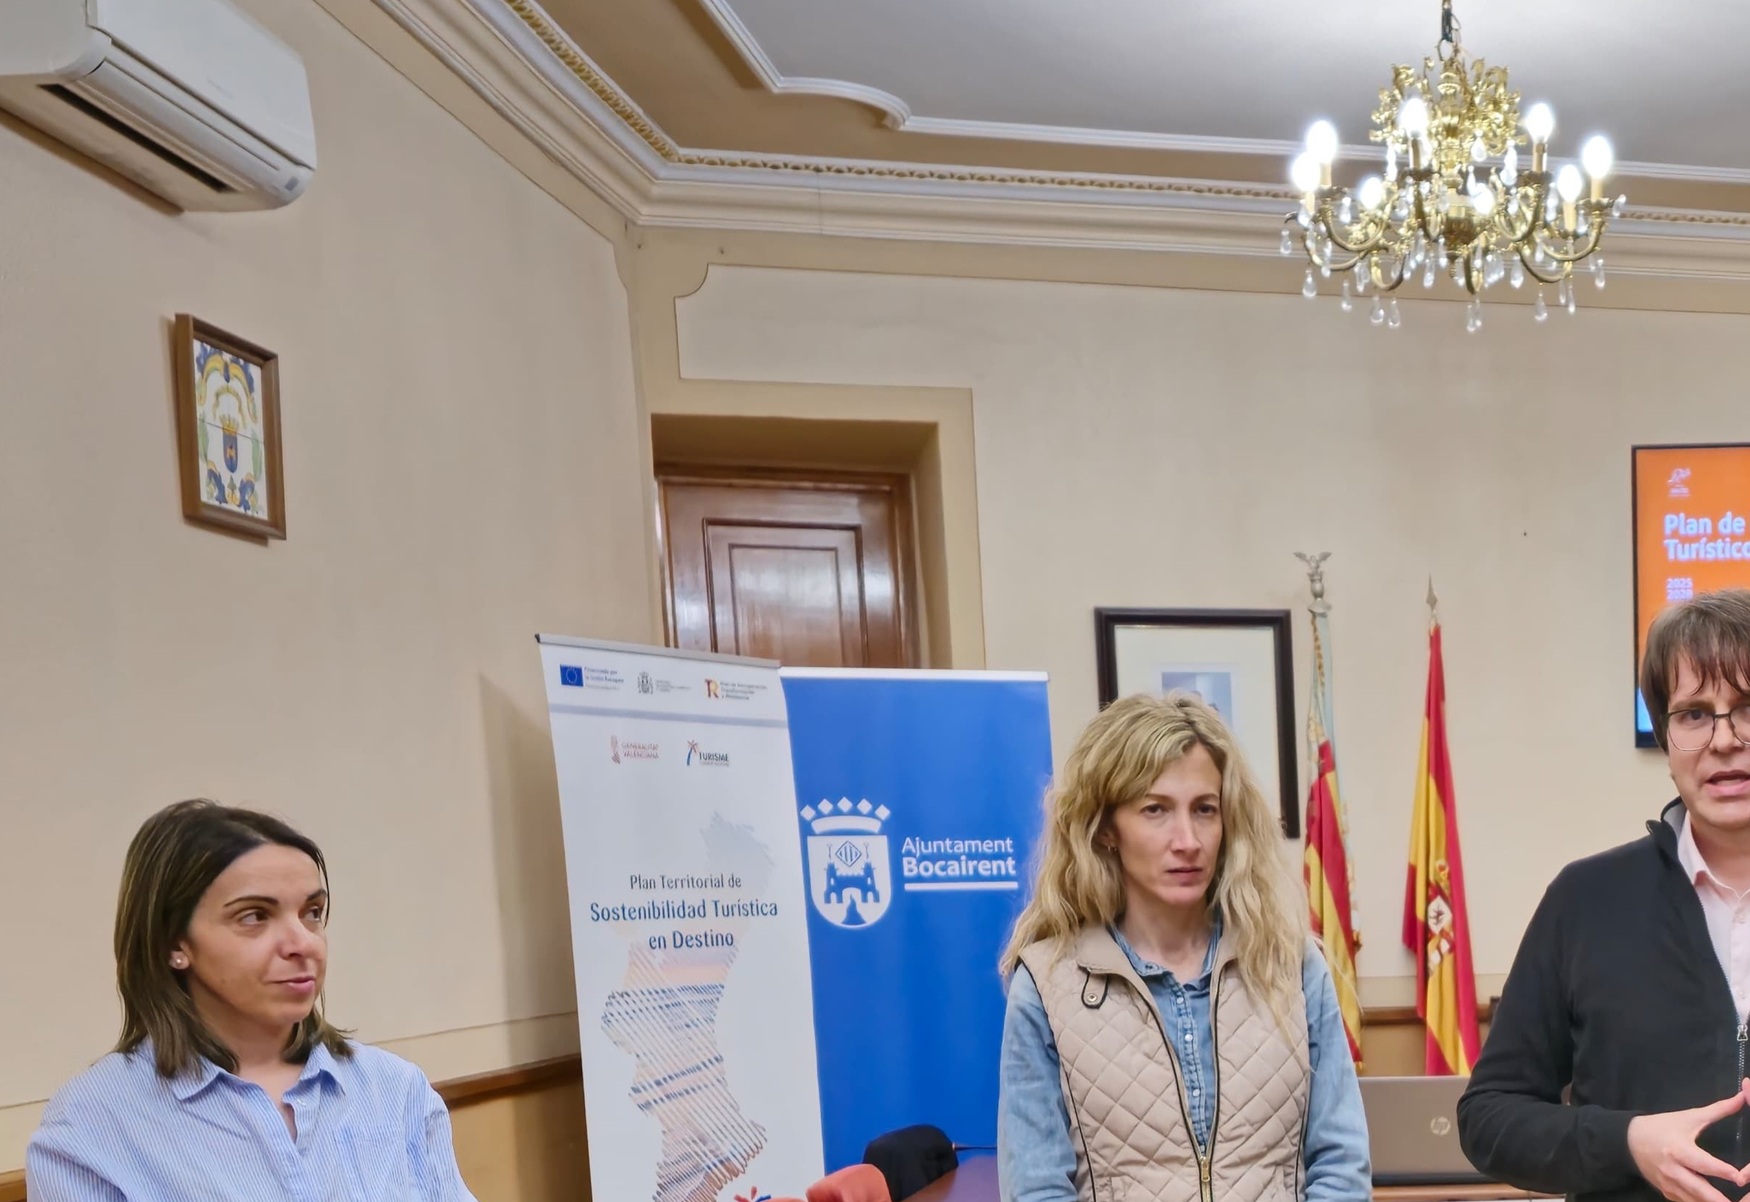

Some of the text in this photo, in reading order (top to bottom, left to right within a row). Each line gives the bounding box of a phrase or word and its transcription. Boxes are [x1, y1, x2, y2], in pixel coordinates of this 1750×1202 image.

[1664, 513, 1712, 535] Plan
[1718, 511, 1746, 534] de
[902, 837, 1014, 858] Ajuntament
[902, 855, 1017, 877] Bocairent
[630, 873, 742, 890] Plan Territorial de
[590, 898, 778, 922] Sostenibilidad Turística
[648, 929, 734, 950] en Destino
